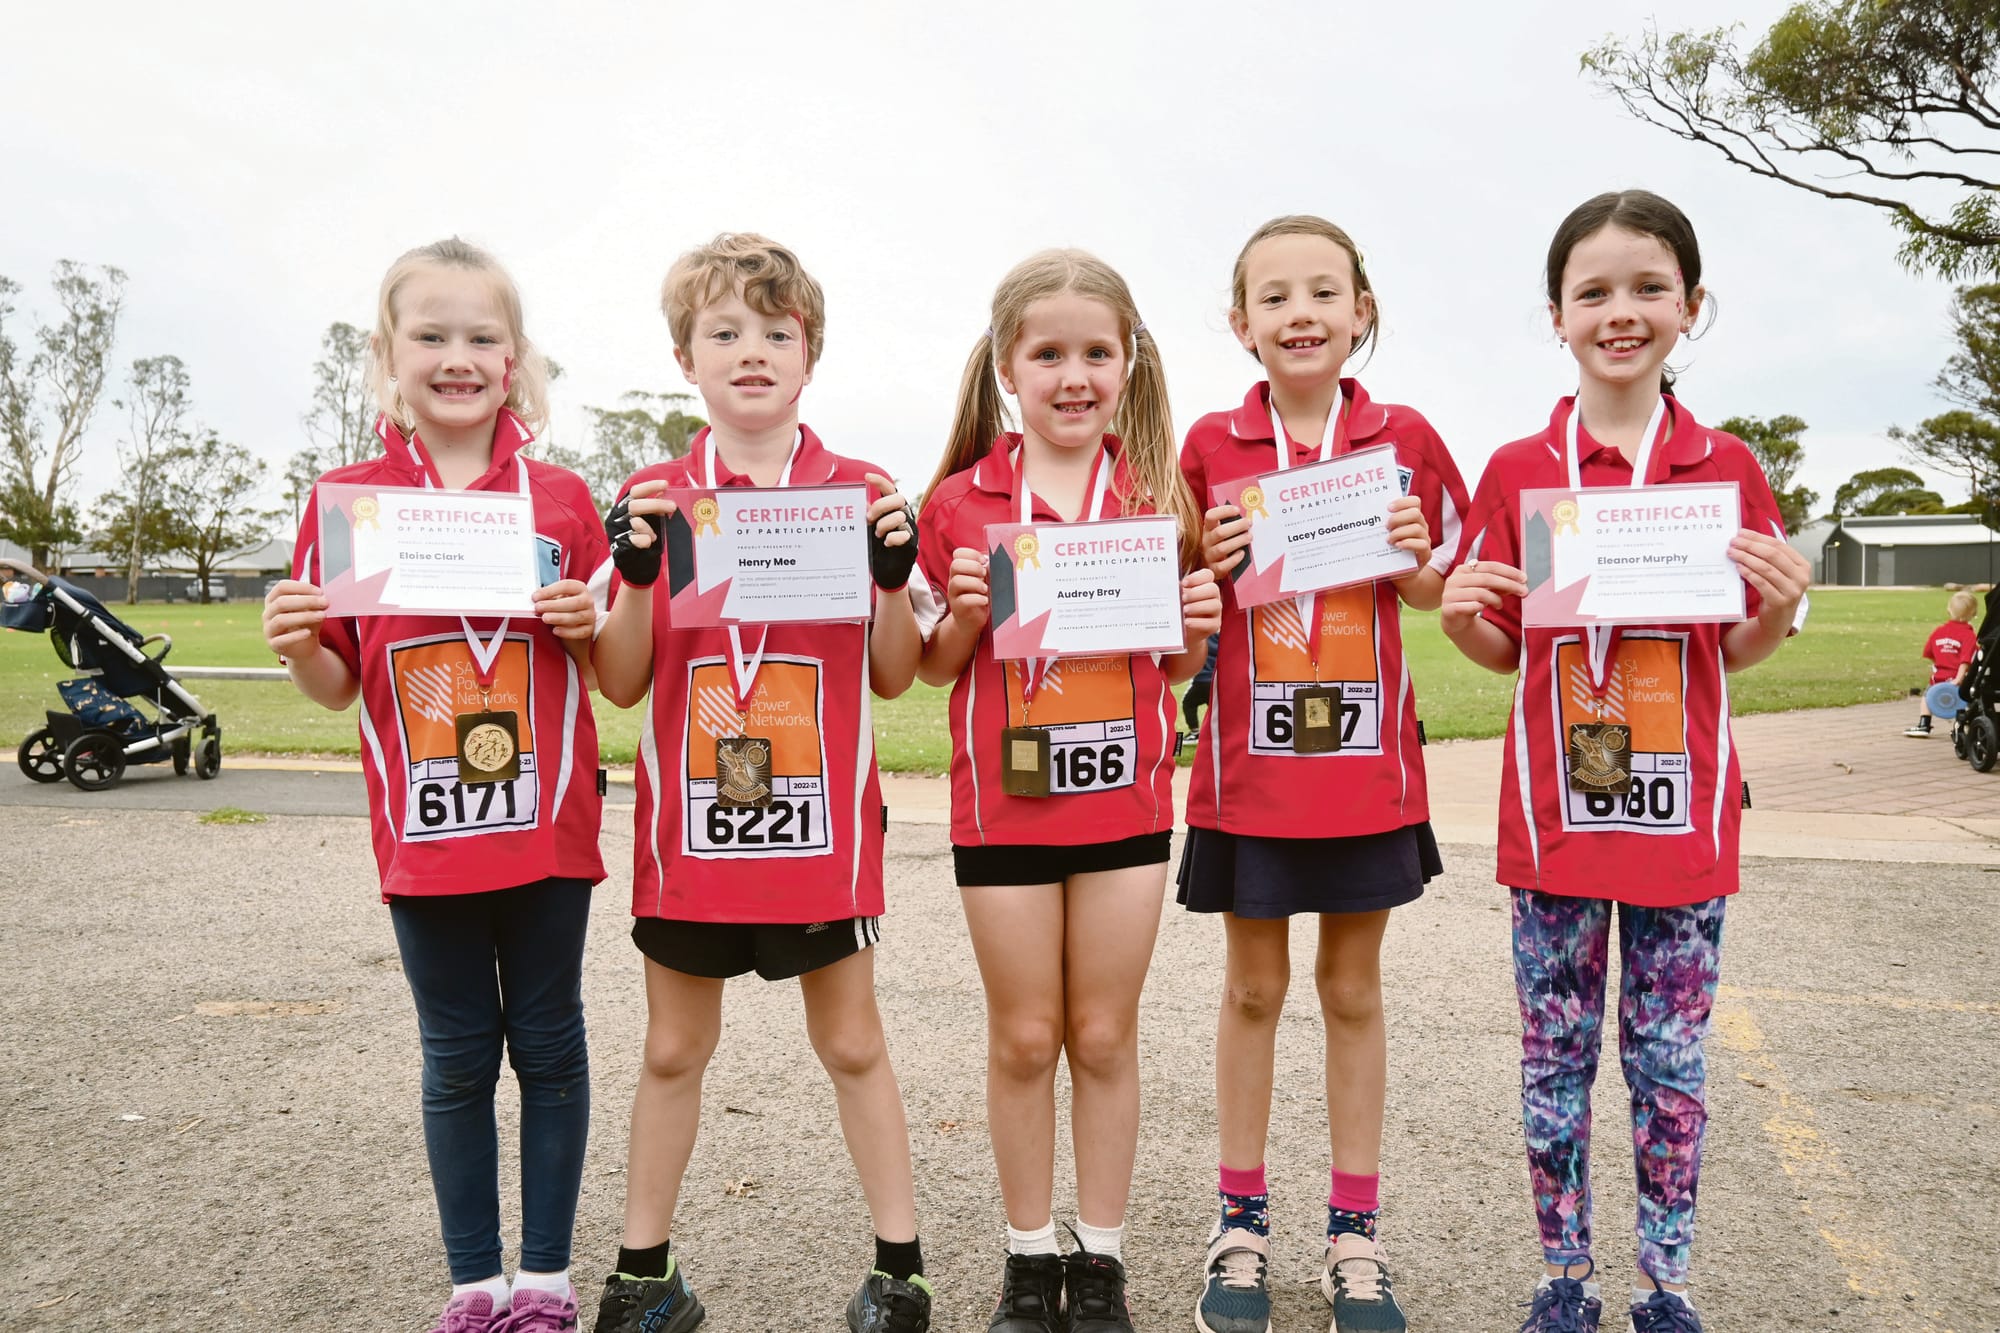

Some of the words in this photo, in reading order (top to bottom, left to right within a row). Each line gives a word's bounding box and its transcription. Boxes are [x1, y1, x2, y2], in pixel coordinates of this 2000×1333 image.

[1279, 467, 1386, 503] CERTIFICATE
[1281, 506, 1294, 514] OF
[1300, 484, 1389, 509] PARTICIPATION
[397, 508, 518, 526] CERTIFICATE
[736, 505, 855, 523] CERTIFICATE
[1596, 504, 1722, 523] CERTIFICATE
[420, 527, 520, 536] PARTICIPATION
[758, 525, 856, 535] PARTICIPATION
[1287, 530, 1316, 543] Lacey
[1317, 515, 1382, 536] Goodenough
[1618, 523, 1723, 534] PARTICIPATION
[1054, 537, 1166, 556] CERTIFICATE
[399, 552, 432, 560] Eloise
[434, 552, 465, 561] Clark
[738, 558, 771, 569] Henry
[773, 558, 796, 566] Mee
[1075, 556, 1167, 567] PARTICIPATION
[1597, 556, 1641, 565] Eleanor
[1643, 553, 1688, 565] Murphy
[1057, 589, 1095, 599] Audrey
[1096, 588, 1121, 598] Bray
[1321, 611, 1348, 622] wer
[1321, 623, 1367, 636] etworks
[455, 661, 475, 676] SA
[1065, 658, 1122, 673] Networks
[1624, 659, 1638, 673] SA
[750, 698, 791, 712] Power
[750, 712, 812, 728] Networks
[1266, 703, 1362, 743] 67
[1110, 724, 1132, 733] 2022-23
[1053, 743, 1125, 788] 166
[792, 782, 818, 790] 2022-23
[419, 781, 516, 827] 6171
[706, 800, 810, 845] 6221
[805, 924, 829, 934] adidas
